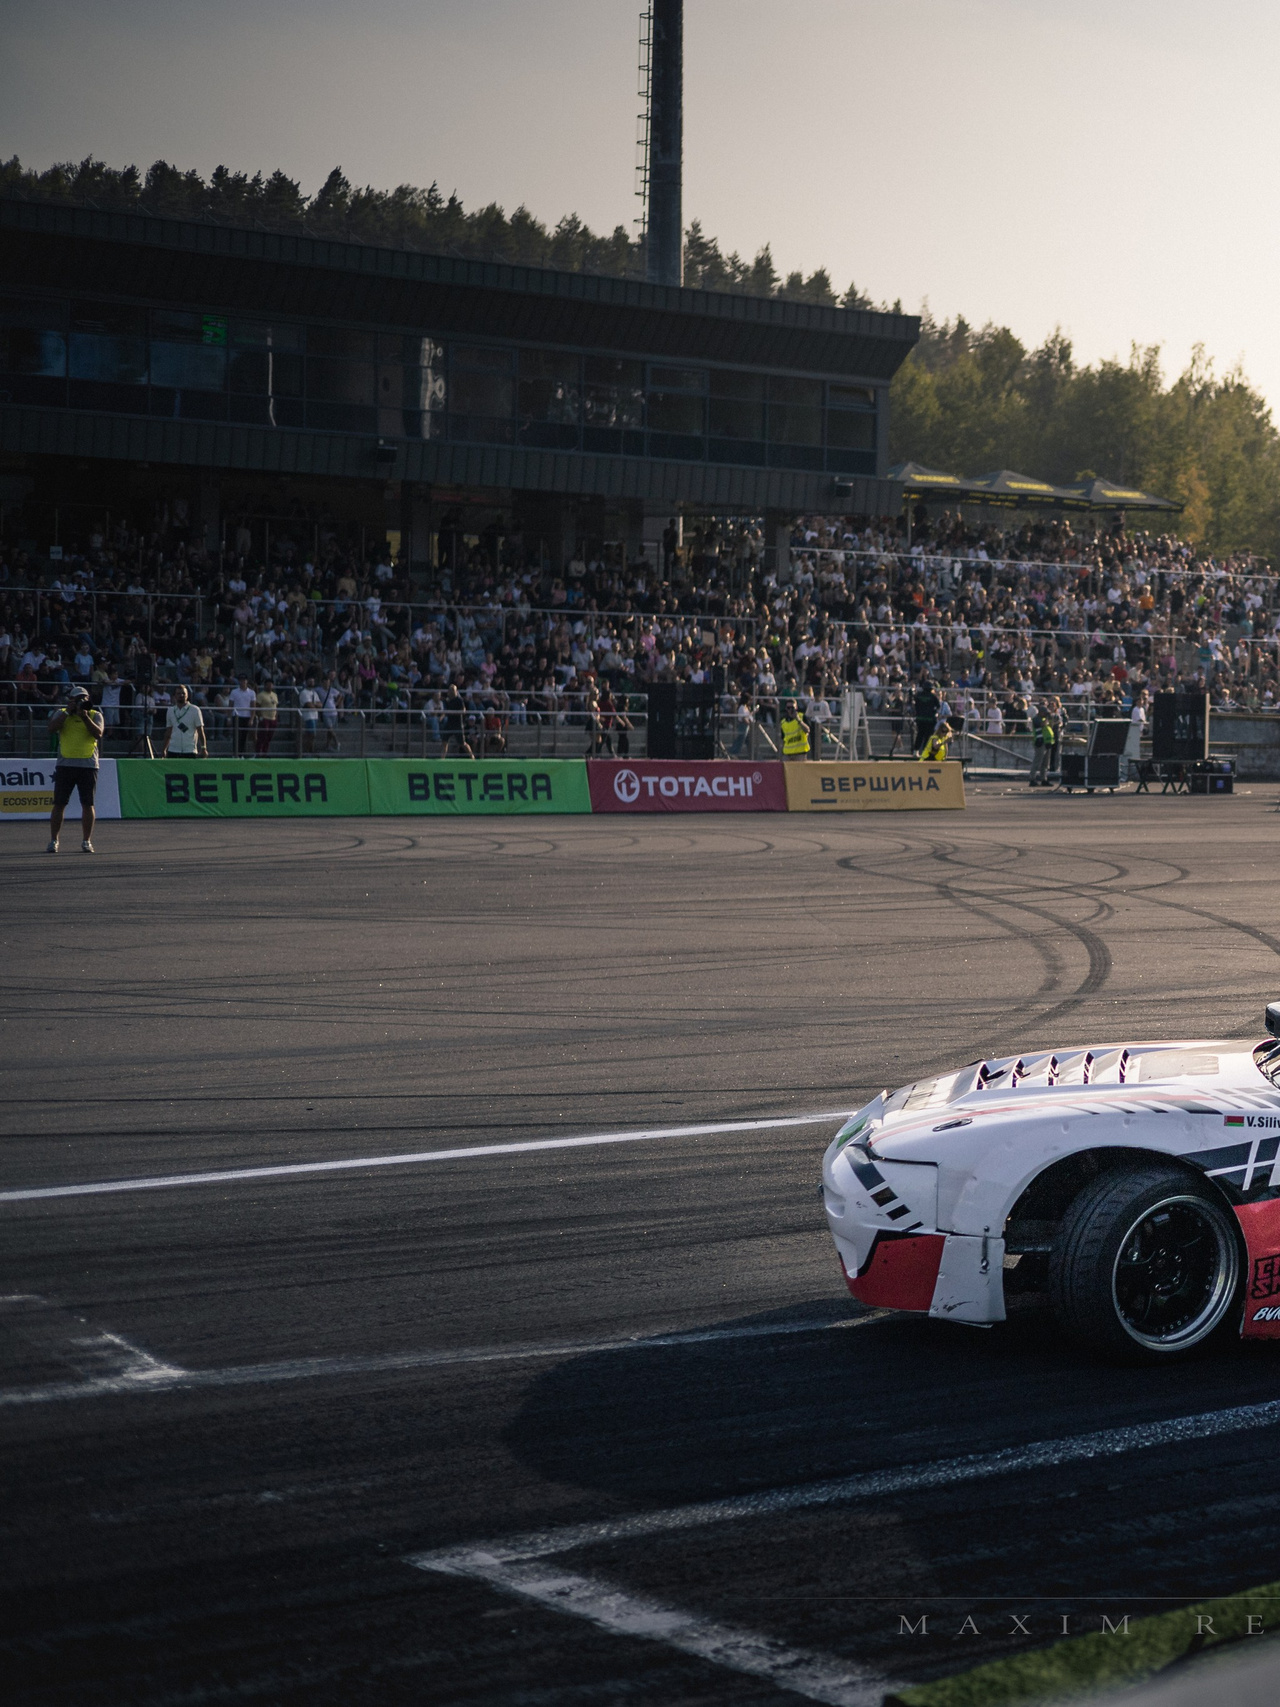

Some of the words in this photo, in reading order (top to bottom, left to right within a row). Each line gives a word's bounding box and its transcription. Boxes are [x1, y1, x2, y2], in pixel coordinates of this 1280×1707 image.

[164, 773, 328, 803] BETERA
[408, 773, 552, 801] BETERA
[642, 776, 753, 796] TOTACHI
[821, 776, 940, 792] ВЕРШИНА
